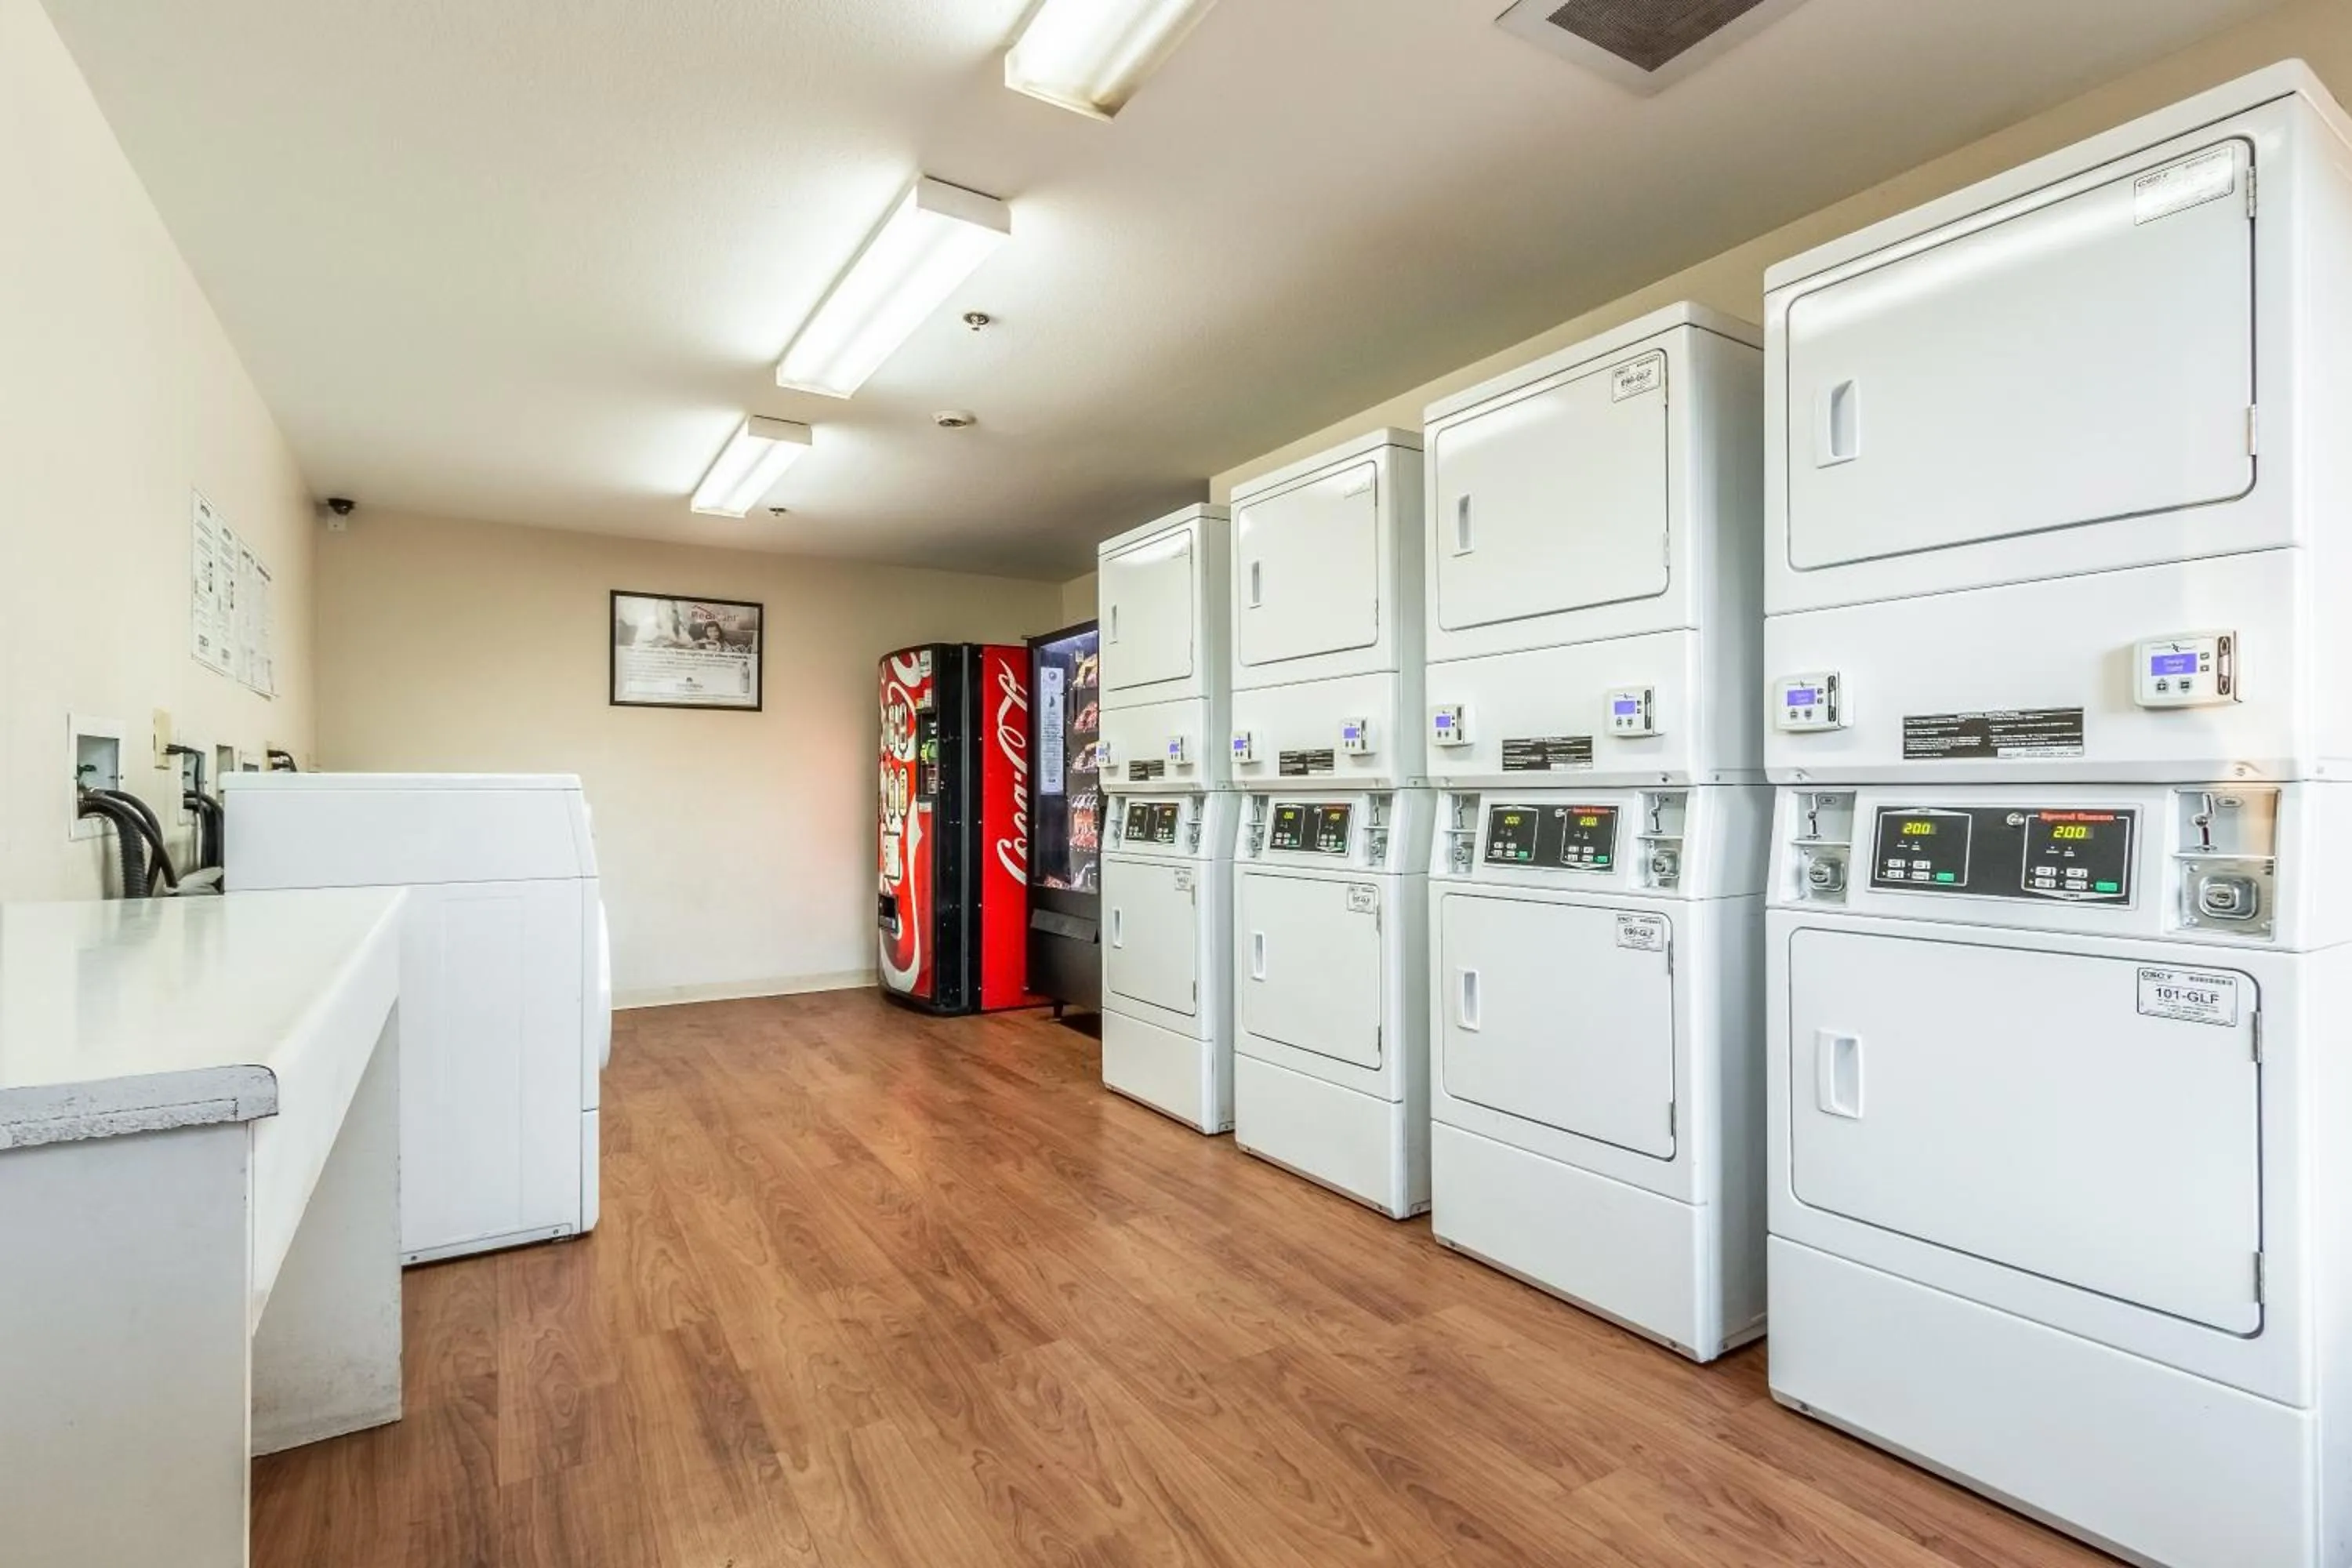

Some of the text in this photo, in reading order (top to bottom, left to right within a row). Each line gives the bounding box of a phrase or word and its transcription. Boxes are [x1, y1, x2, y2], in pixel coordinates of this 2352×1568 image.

[996, 658, 1028, 885] Coca-Cl
[1904, 822, 1931, 835] 200
[2053, 826, 2086, 838] 200
[2155, 987, 2220, 1004] 101-GLF
